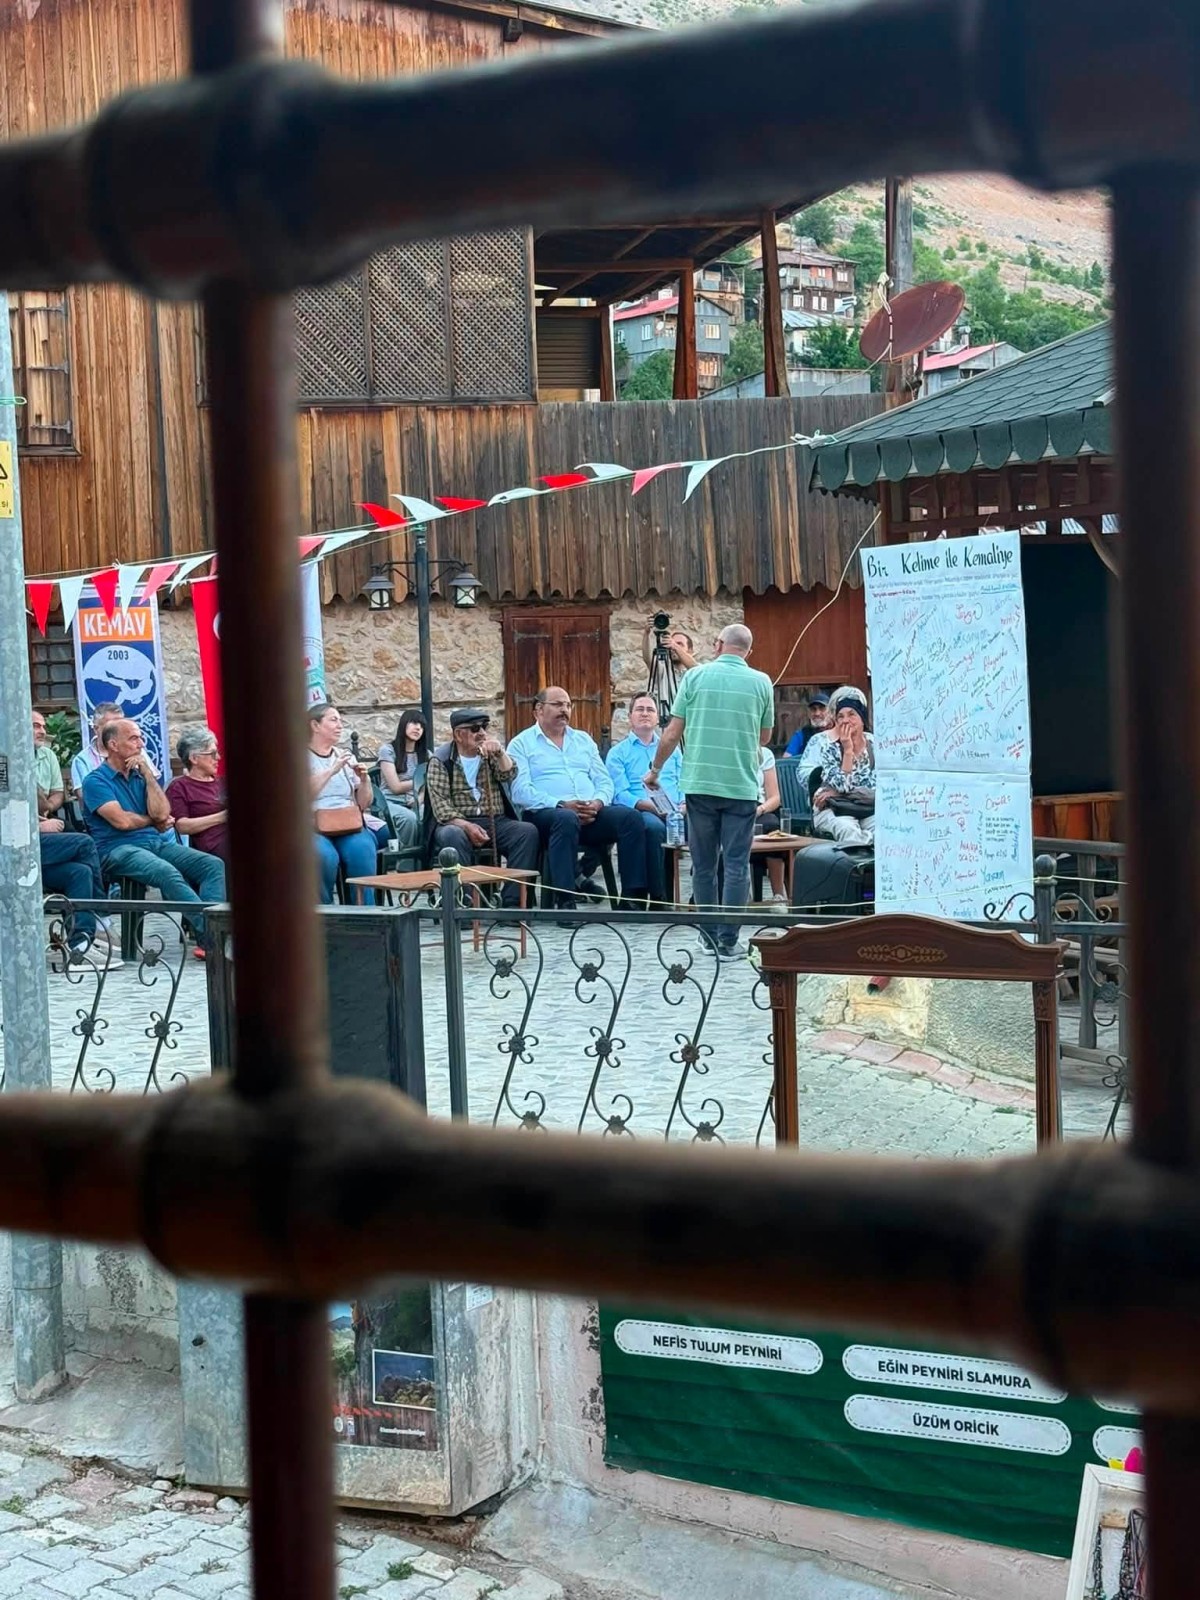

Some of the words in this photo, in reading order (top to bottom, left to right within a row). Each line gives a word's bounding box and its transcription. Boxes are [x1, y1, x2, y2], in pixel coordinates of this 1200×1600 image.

[867, 554, 889, 578] Bir
[901, 551, 940, 574] Kelime
[945, 547, 958, 569] ile
[964, 543, 1013, 569] Kemaliye
[84, 612, 146, 637] KEMAV
[107, 649, 129, 661] 2003
[965, 721, 992, 744] SPOR
[653, 1334, 687, 1349] NEFİS
[690, 1339, 731, 1355] TULUM
[734, 1344, 782, 1361] PEYNİRİ
[878, 1359, 908, 1375] EĞİN
[912, 1365, 964, 1382] PEYNİRİ
[967, 1370, 1032, 1390] SLAMURA
[913, 1413, 950, 1431] ÜZÜM
[954, 1419, 999, 1436] ORİCİK
